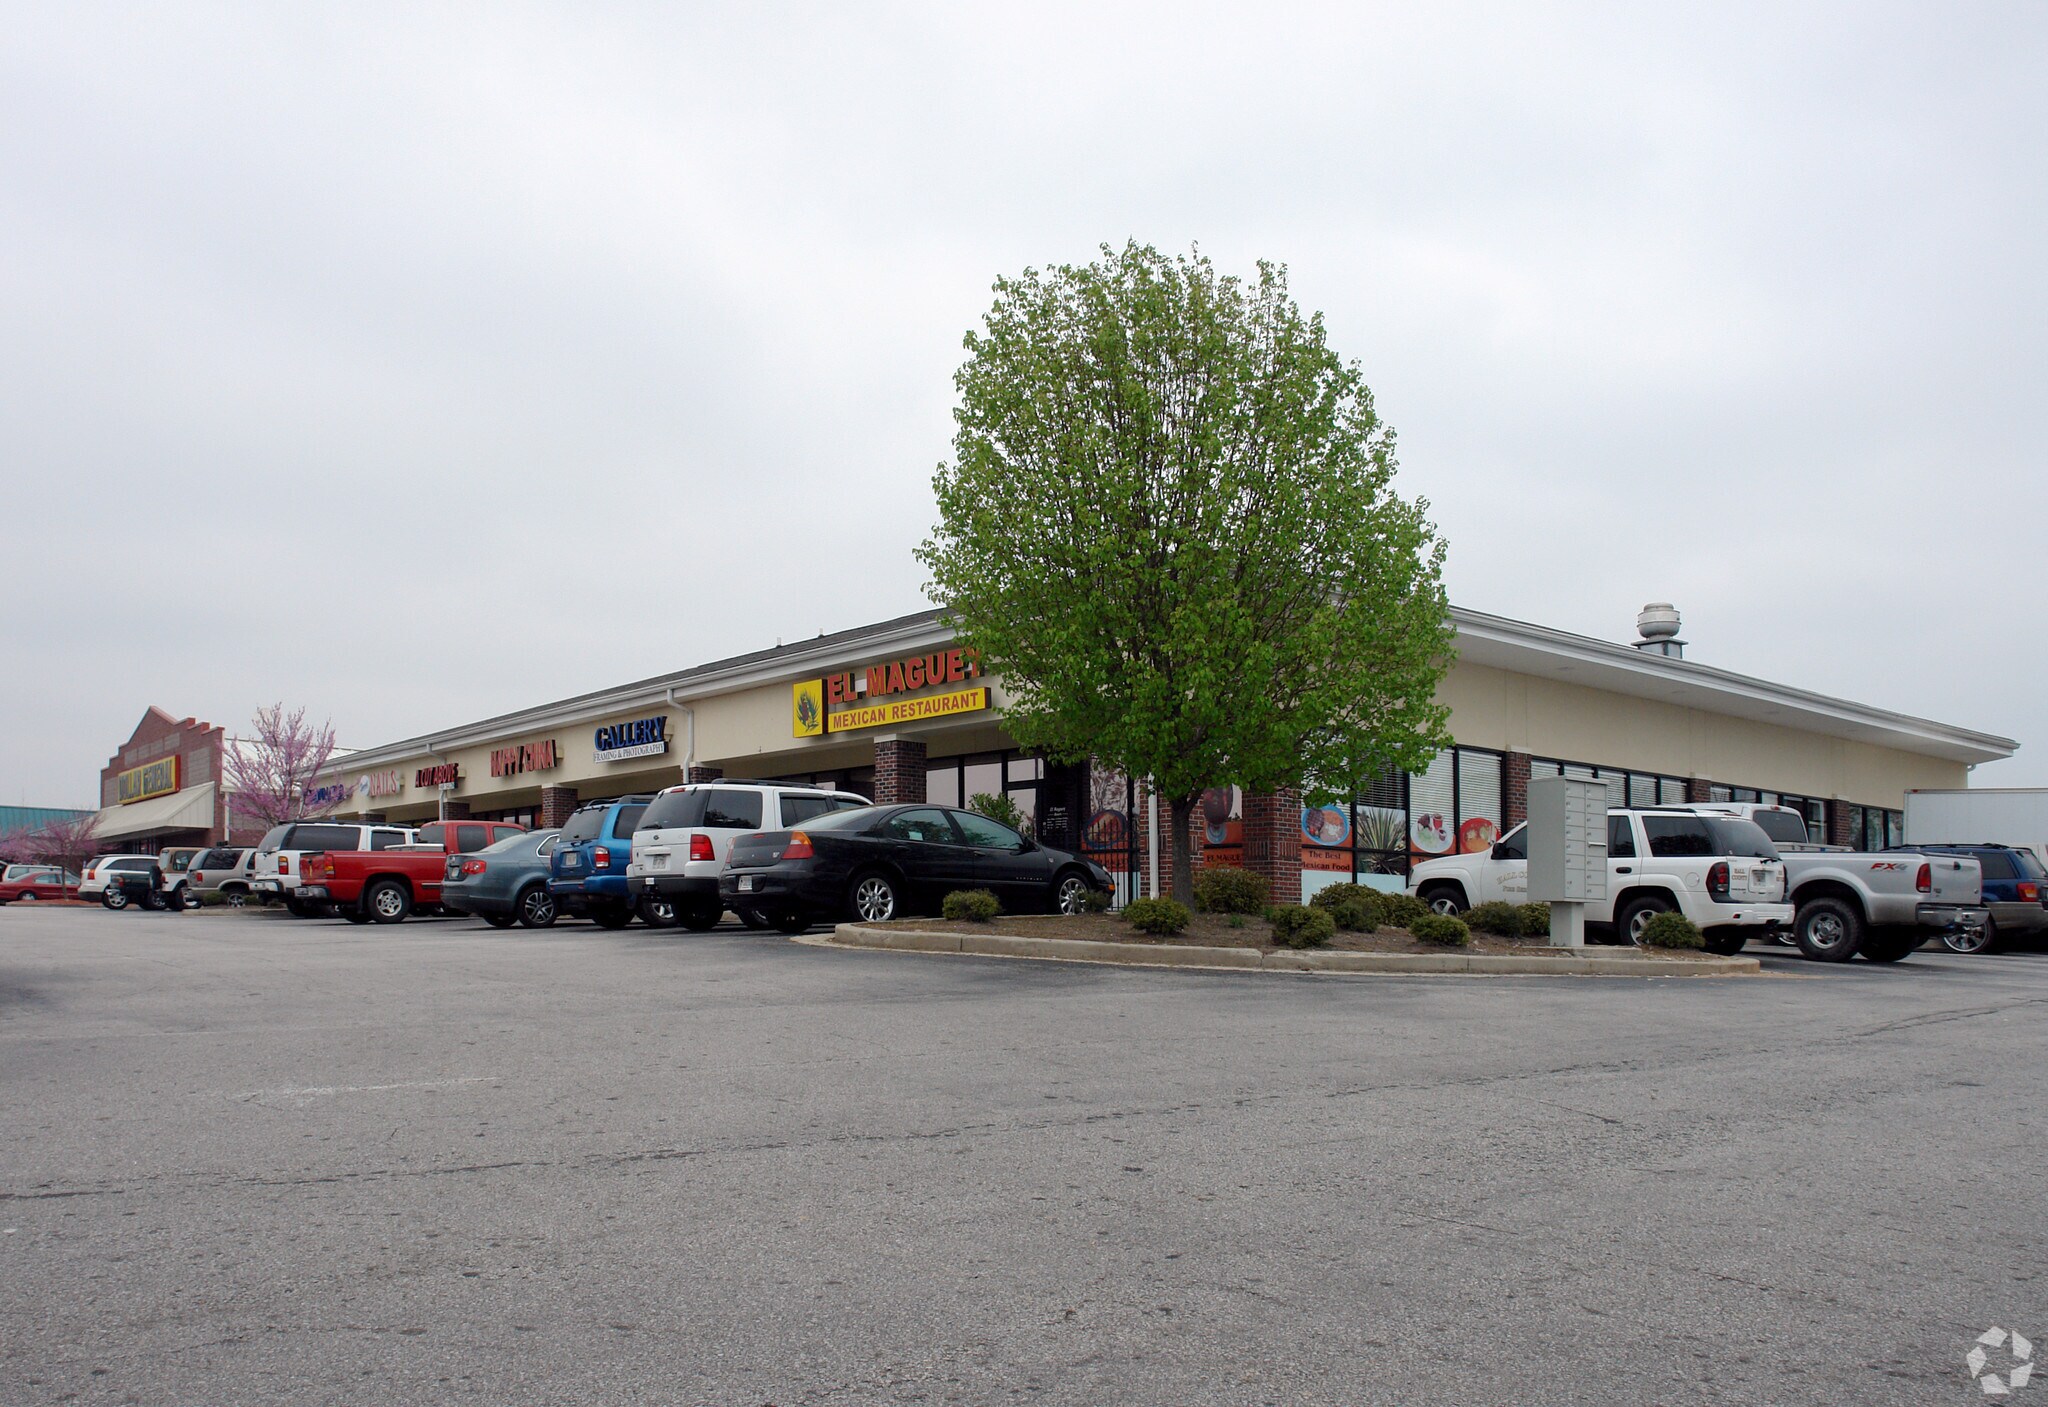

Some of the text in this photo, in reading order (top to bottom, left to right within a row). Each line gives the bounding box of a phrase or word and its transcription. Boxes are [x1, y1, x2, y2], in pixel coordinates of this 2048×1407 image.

[828, 648, 982, 704] EL MAGUEY
[833, 692, 978, 729] MEXICAN RESTAURANT
[594, 716, 667, 751] GALLERY
[490, 739, 556, 777] HAPPY CHINA
[594, 743, 664, 761] FRAMING & PHOTOGRAPHY
[119, 760, 173, 801] DOLLAR GENERAL
[369, 769, 398, 797] NAILS
[415, 763, 458, 788] A CUT ABOVE
[1332, 863, 1350, 871] Food
[1871, 863, 1908, 871] FX4
